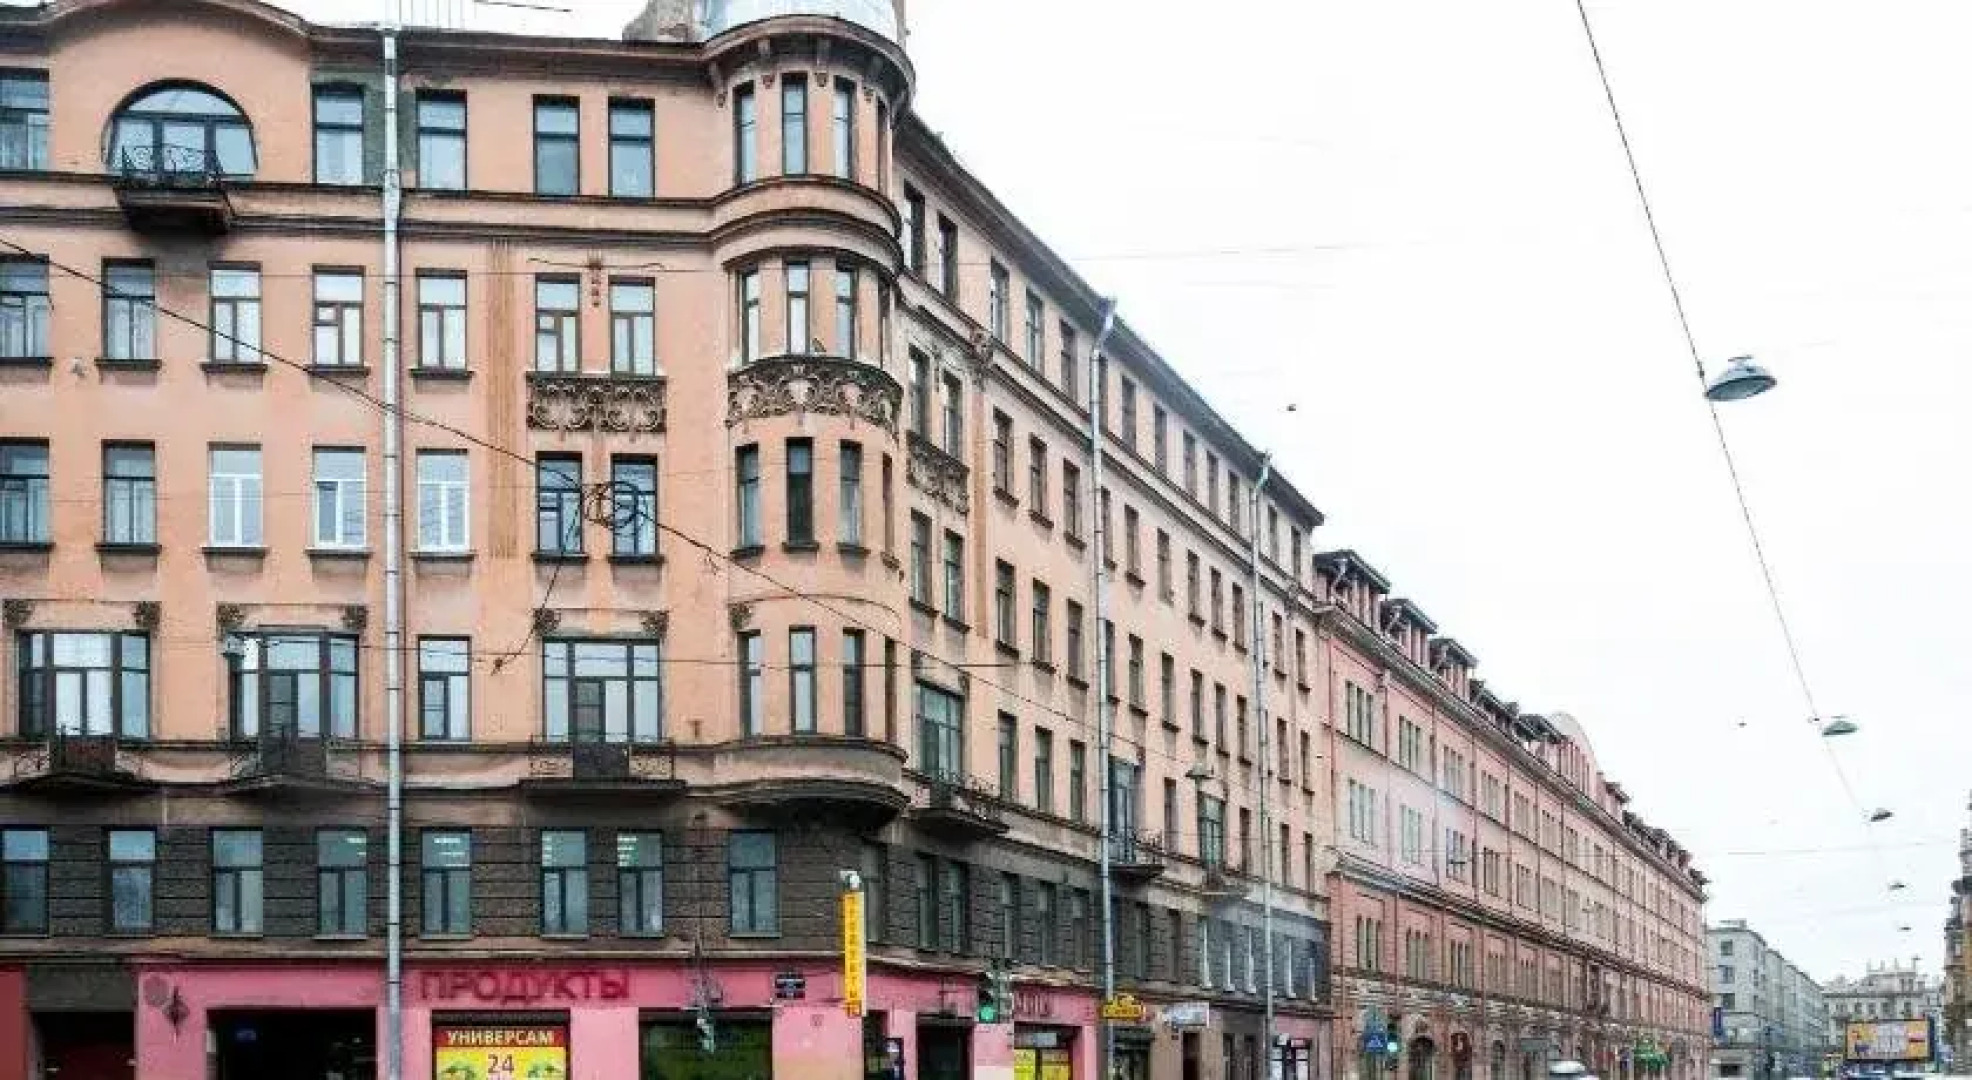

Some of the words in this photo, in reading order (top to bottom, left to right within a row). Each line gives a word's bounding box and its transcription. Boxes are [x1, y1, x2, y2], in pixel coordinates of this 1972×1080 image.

[421, 971, 629, 1005] ПРОДУКТЫ
[447, 1029, 555, 1046] УНИВЕРСАМ
[487, 1053, 515, 1074] 24
